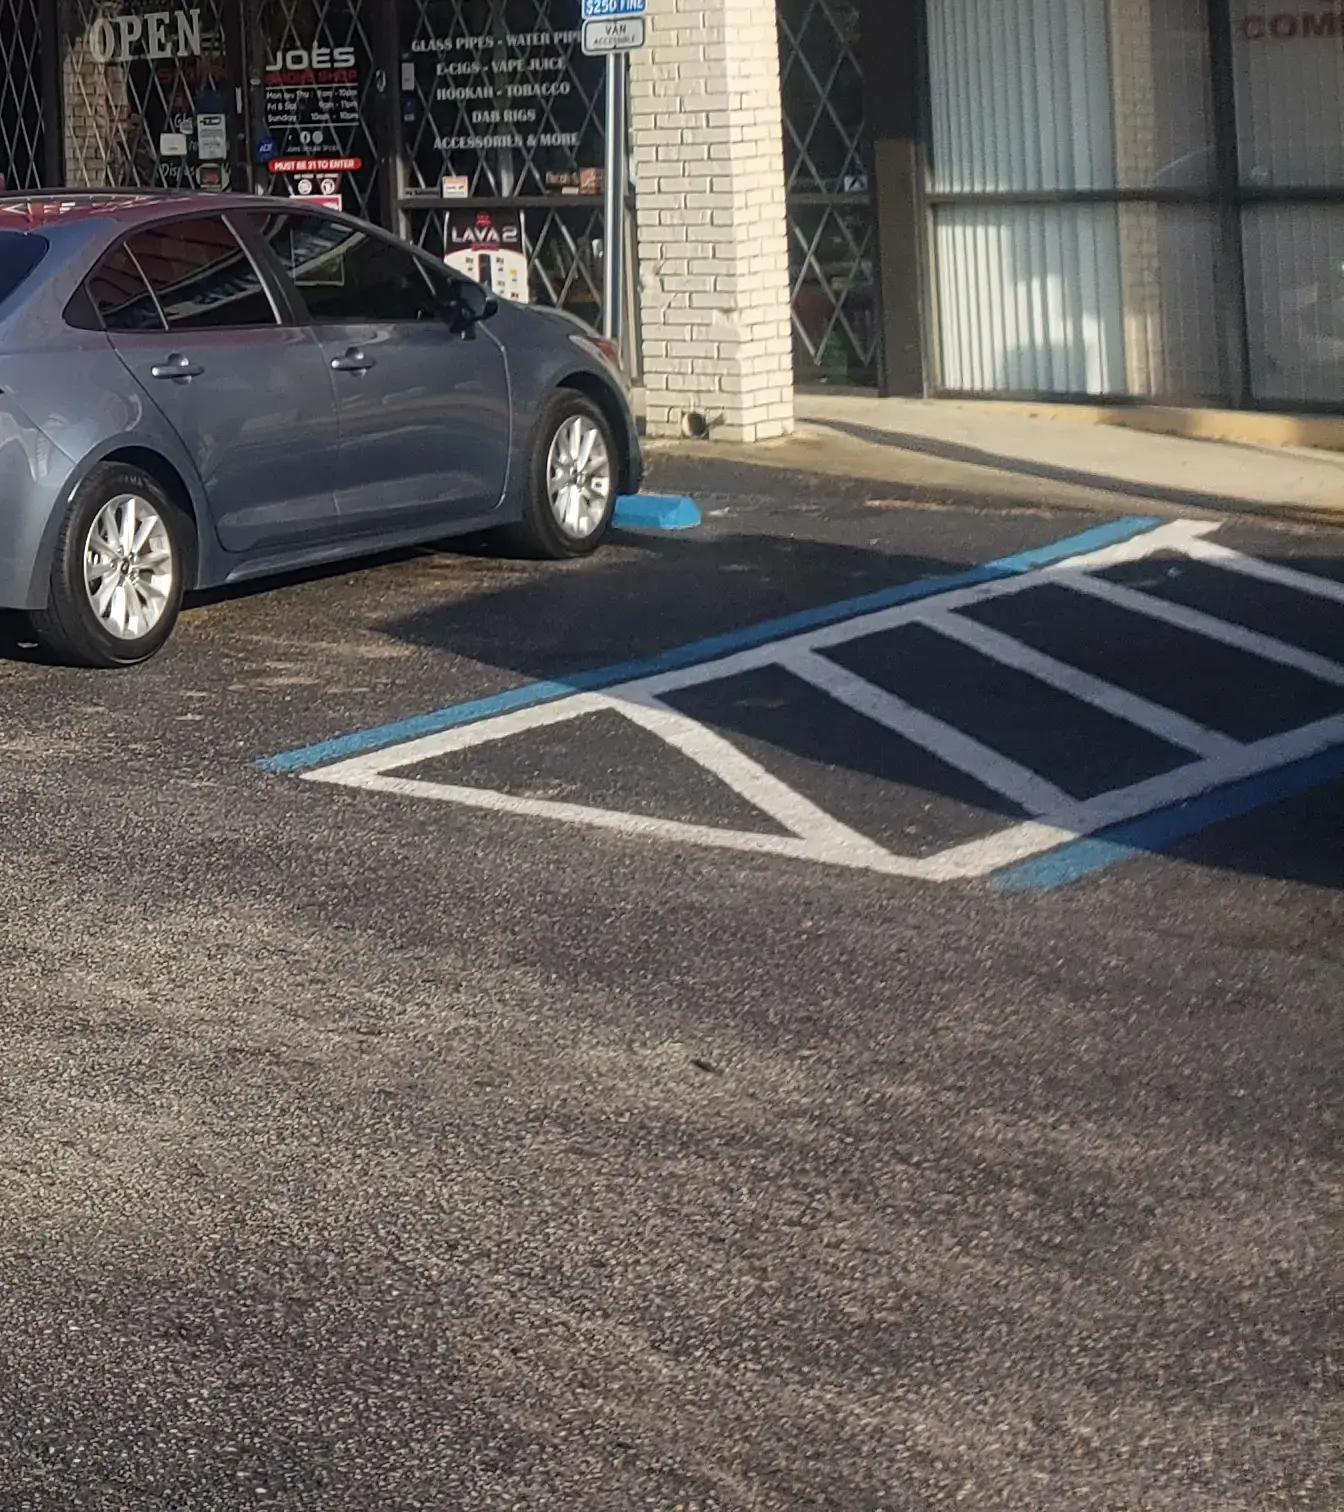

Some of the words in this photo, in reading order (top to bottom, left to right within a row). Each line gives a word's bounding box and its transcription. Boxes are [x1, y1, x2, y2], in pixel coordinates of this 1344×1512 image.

[605, 24, 627, 36] VAN
[1241, 12, 1344, 39] COM
[89, 8, 201, 64] OPEN
[412, 37, 452, 52] GLASS
[456, 35, 494, 50] PIPES
[506, 32, 550, 47] WATER
[265, 46, 356, 71] JOES
[436, 61, 480, 76] E-CIGS
[491, 59, 525, 73] VAPE
[528, 57, 567, 72] JUICE
[436, 86, 492, 101] HOOKAH
[505, 82, 570, 98] TOBACCO
[472, 110, 500, 124] DAB
[503, 108, 536, 122] RIGS
[433, 134, 523, 150] ACCESSORIES
[526, 134, 536, 147] &
[539, 132, 580, 147] MORE
[274, 161, 295, 171] MUST
[318, 160, 328, 169] TO
[330, 159, 355, 169] ENTER
[451, 227, 499, 243] LAVA
[501, 226, 518, 242] 2
